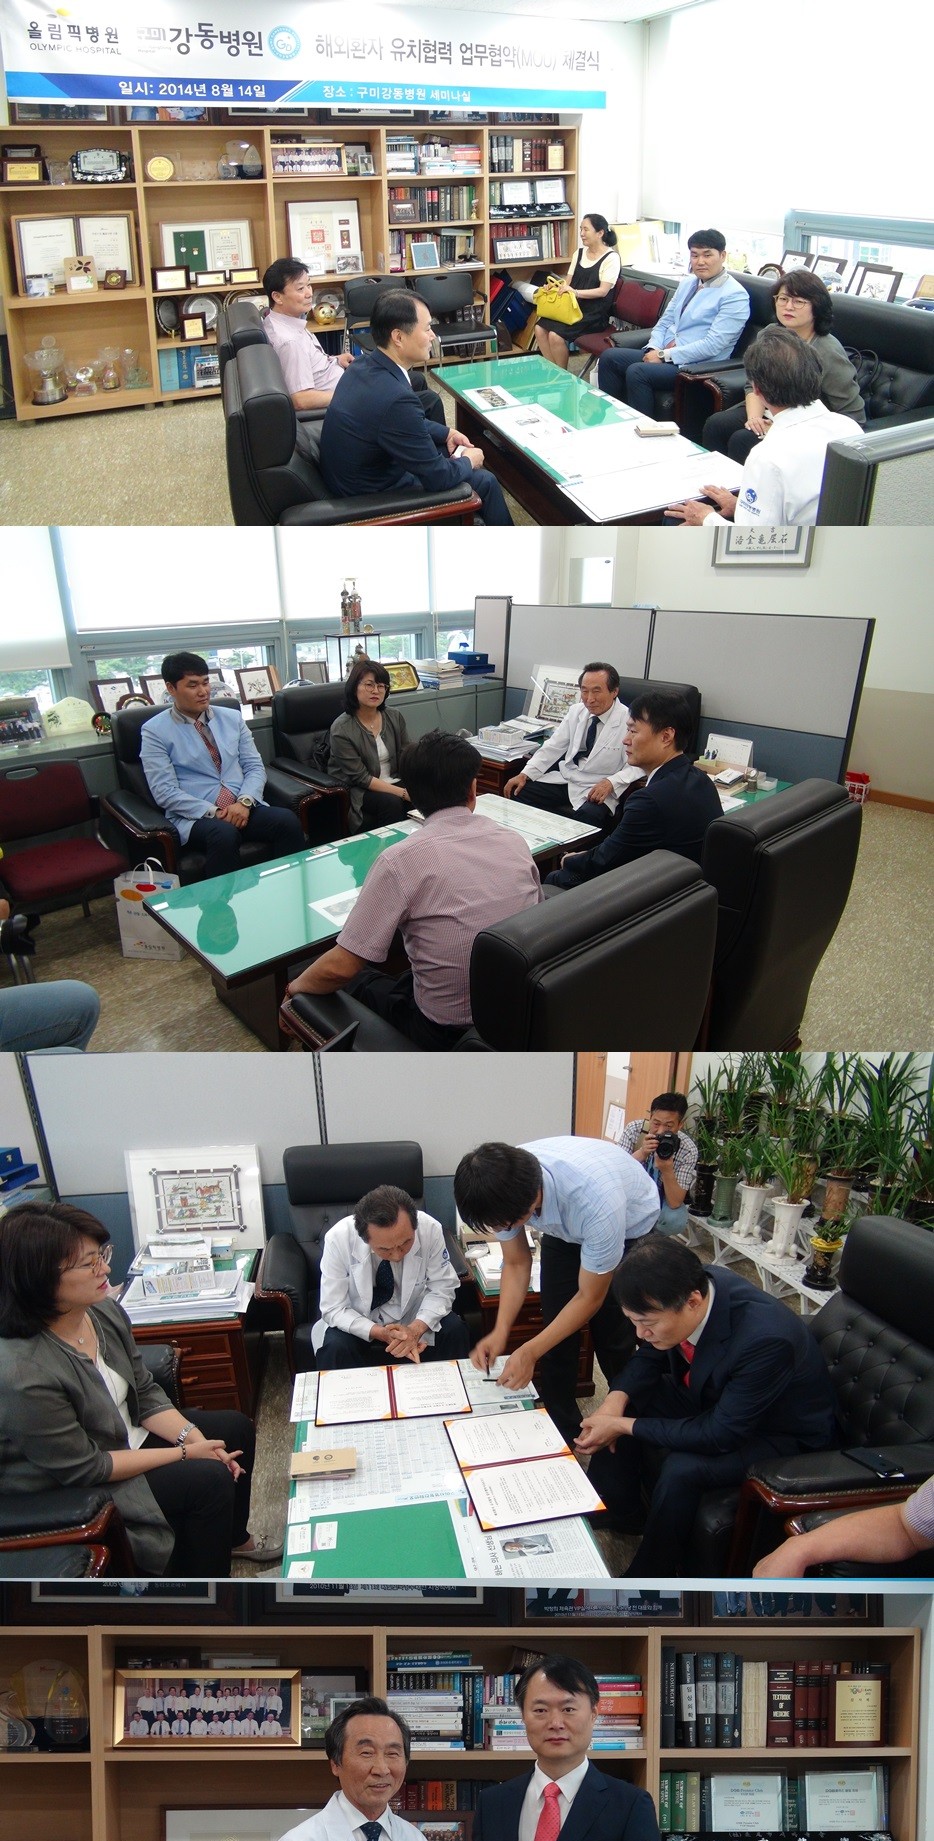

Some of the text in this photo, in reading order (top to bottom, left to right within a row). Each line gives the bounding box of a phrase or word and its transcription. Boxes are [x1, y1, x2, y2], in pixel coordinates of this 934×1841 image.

[27, 21, 119, 44] 올림픽병원
[170, 22, 264, 57] 강동병원
[30, 43, 121, 55] OLYMPIC HOSPITAL
[315, 34, 383, 60] 해외환자
[390, 38, 452, 65] 유치협력
[562, 49, 600, 72] 체결식
[119, 81, 266, 97] 일시: 2014년 8월 14일
[322, 85, 346, 98] 장소
[357, 86, 426, 101] 구미강동병원
[430, 89, 471, 102] 세미나실
[489, 1552, 499, 1564] 의사
